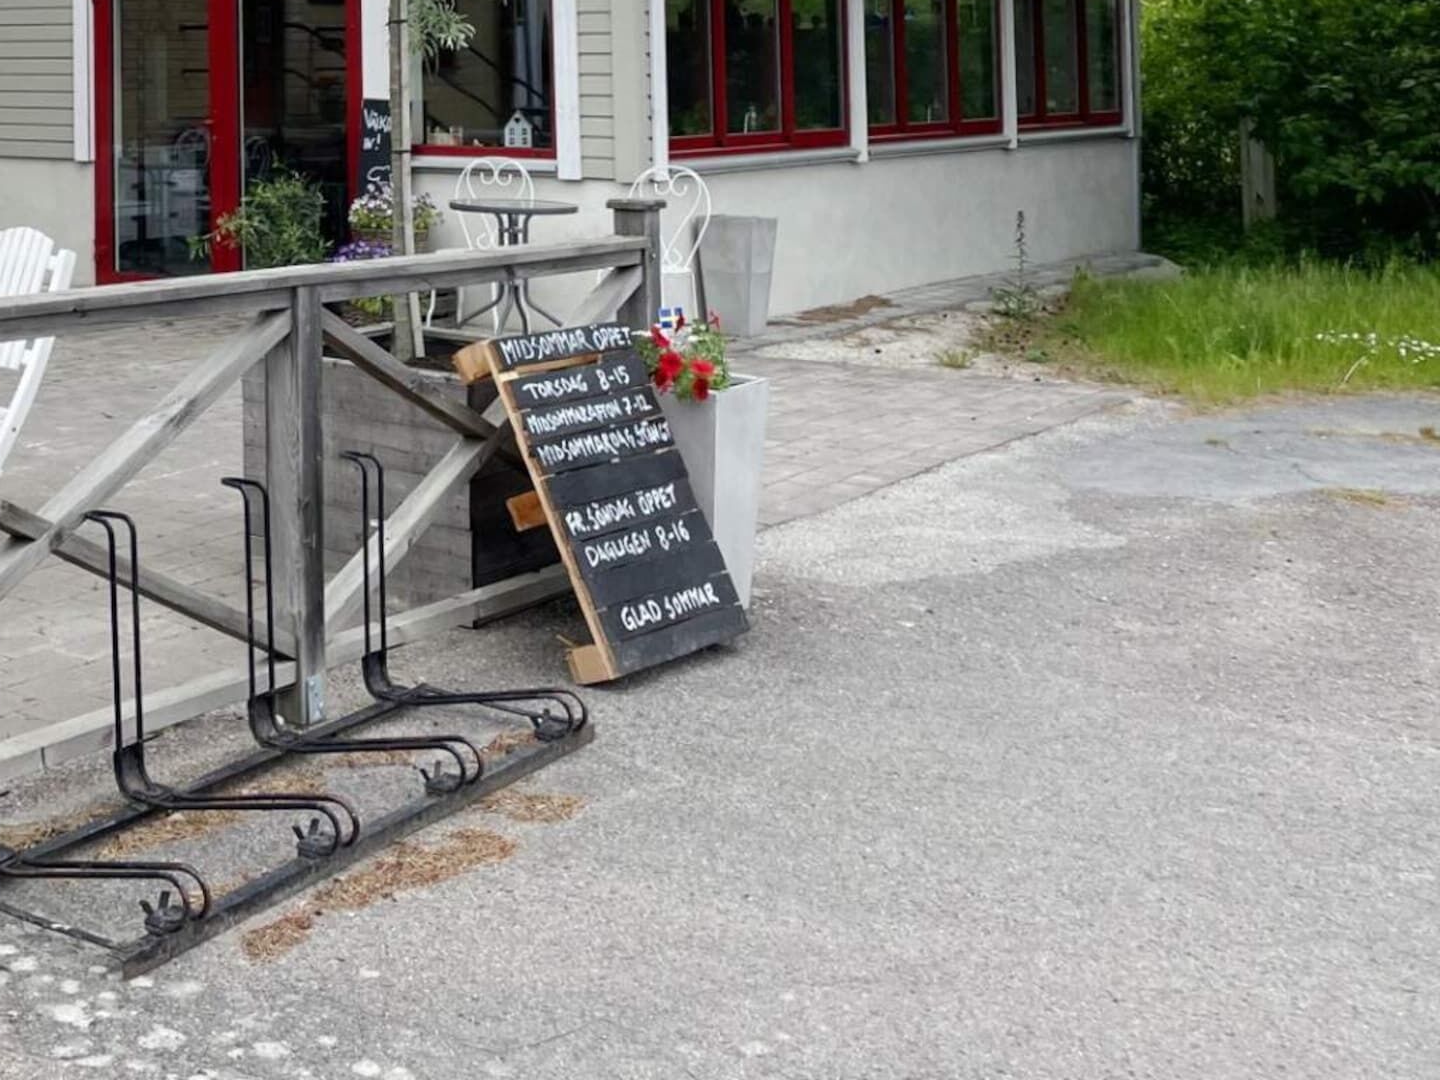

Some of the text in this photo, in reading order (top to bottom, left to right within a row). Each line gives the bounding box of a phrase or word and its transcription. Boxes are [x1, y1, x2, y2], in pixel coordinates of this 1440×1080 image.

[499, 324, 633, 365] MIDSOMMAR ÖPPET
[522, 366, 631, 400] TORSDAG 8-15
[526, 398, 622, 435] MIDSOMMARAFTON
[536, 426, 637, 467] MIDSOMMARDAG
[635, 483, 677, 516] ÖPPET
[655, 520, 691, 551] 8-16
[620, 582, 720, 632] GLAD SOMMAR
